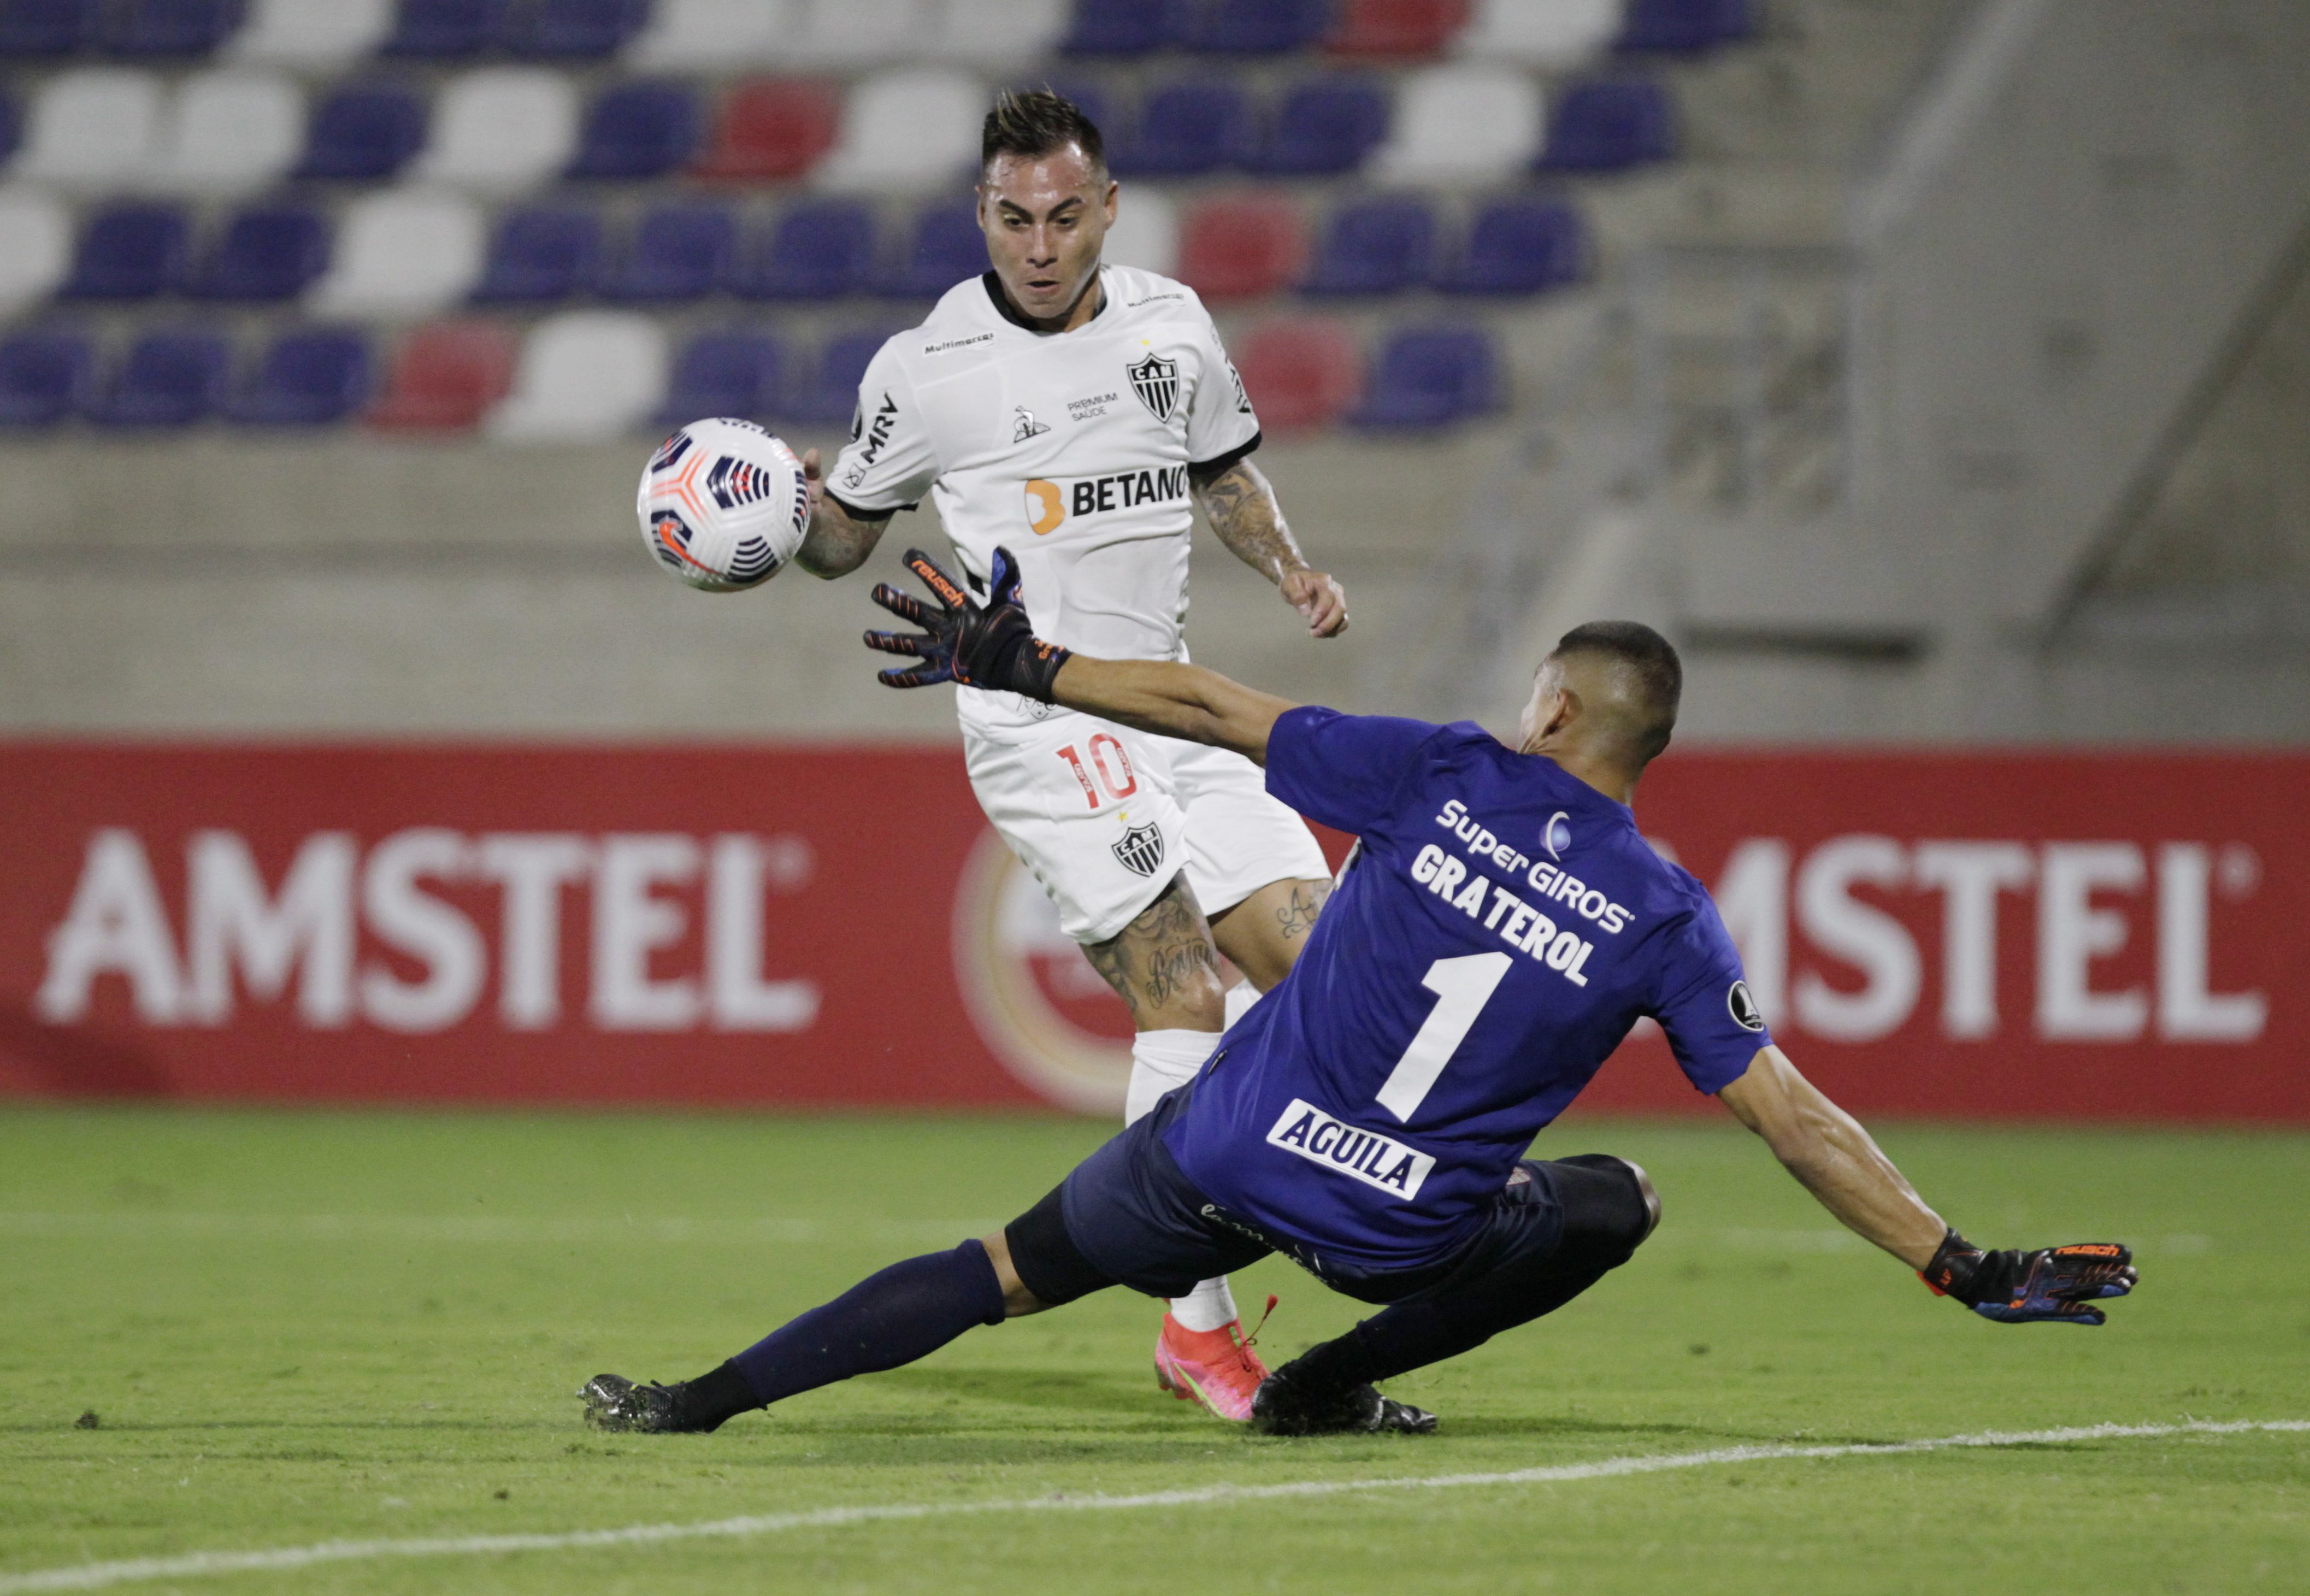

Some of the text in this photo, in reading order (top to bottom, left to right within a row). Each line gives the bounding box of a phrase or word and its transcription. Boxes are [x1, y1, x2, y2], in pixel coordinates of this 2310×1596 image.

[924, 333, 994, 355] Multimarcas
[1135, 364, 1172, 380] CAM
[860, 391, 899, 464] MRV
[1072, 464, 1186, 517] BETANO
[911, 558, 965, 608] reusch
[1056, 733, 1137, 809] 10
[1121, 830, 1154, 853] CAM
[33, 824, 820, 1034] AMSTEL
[1410, 844, 1594, 988] GRATEROL
[1375, 951, 1513, 1124] 1
